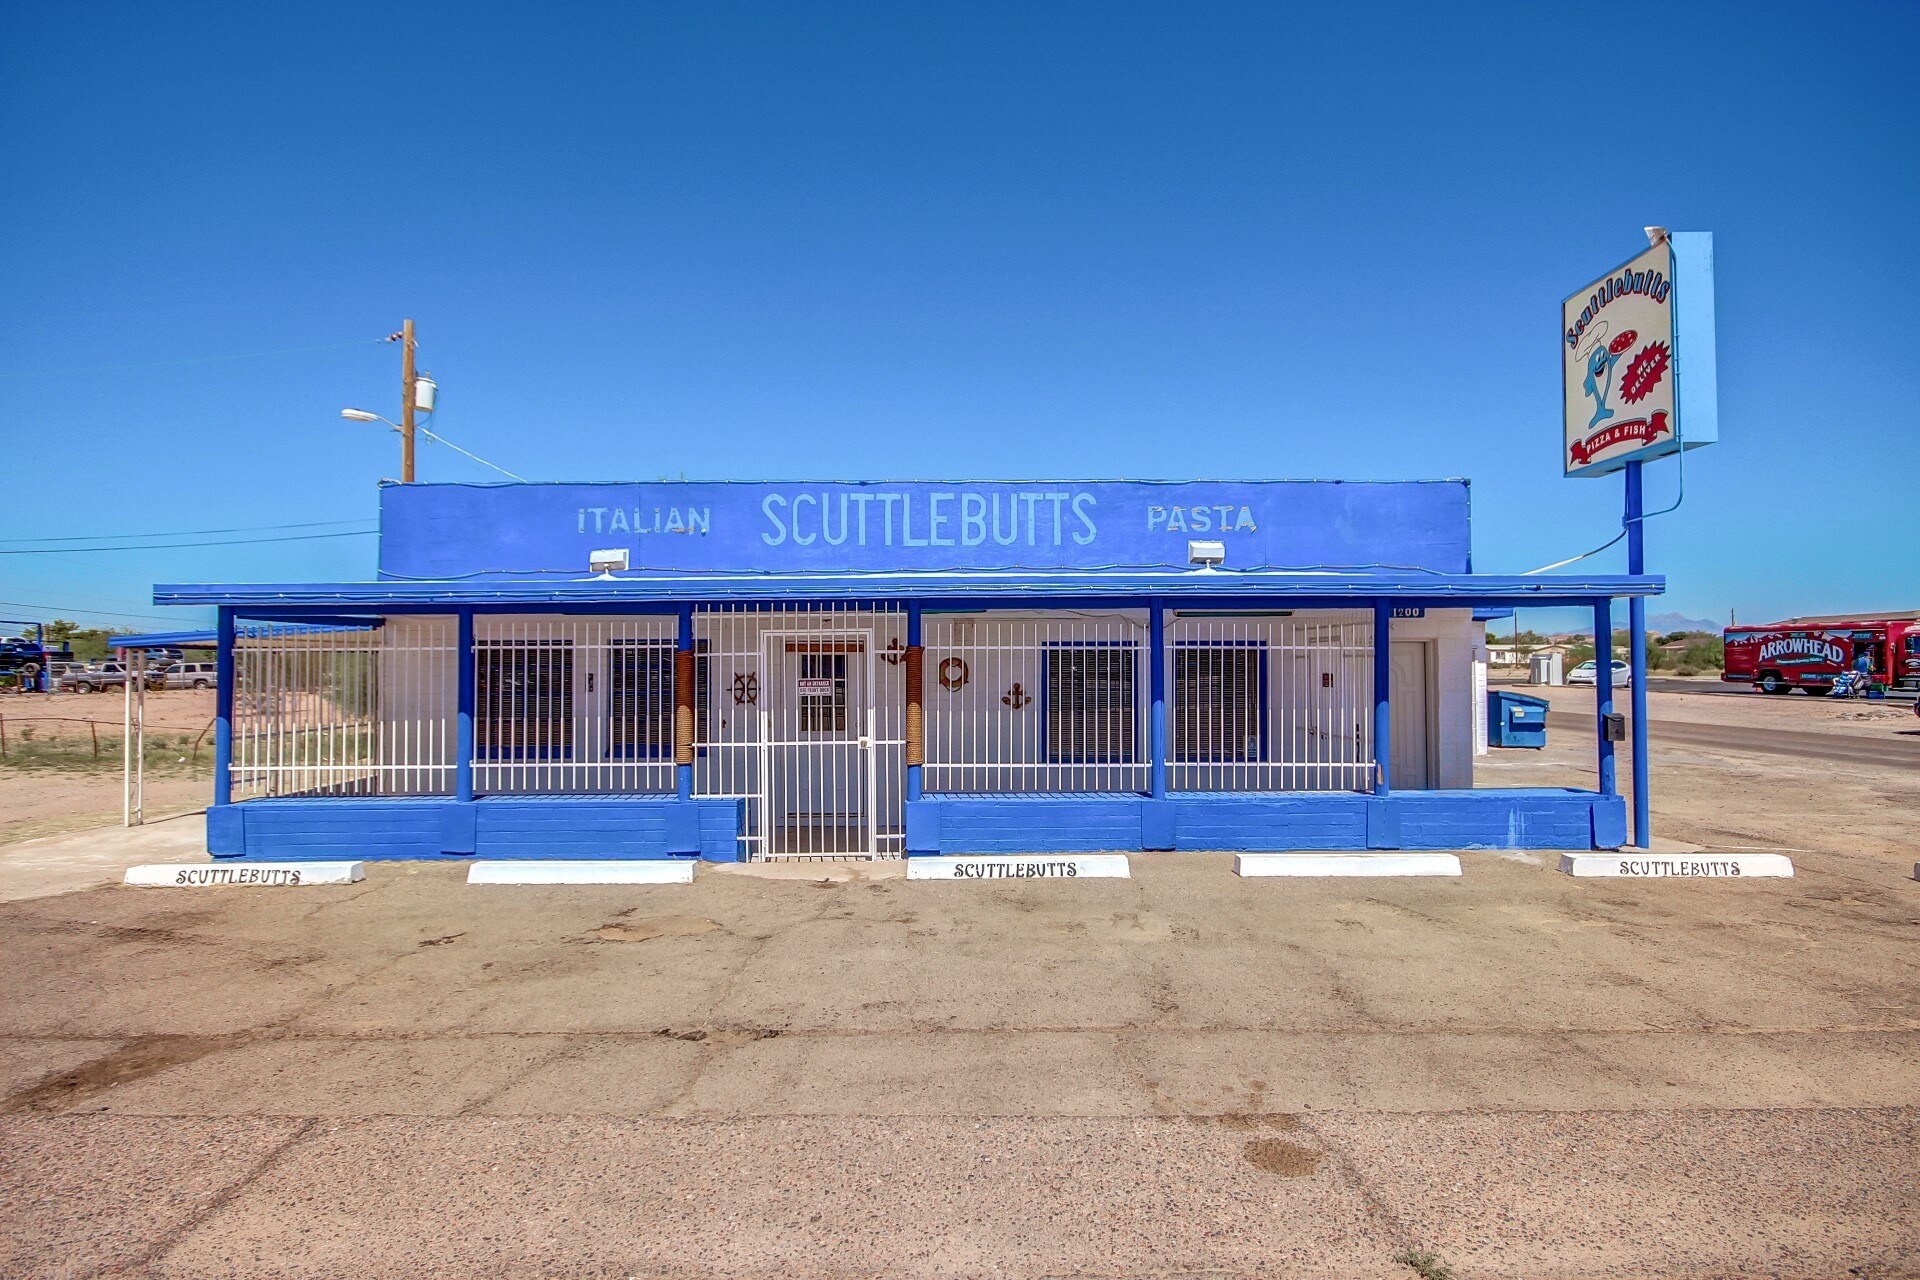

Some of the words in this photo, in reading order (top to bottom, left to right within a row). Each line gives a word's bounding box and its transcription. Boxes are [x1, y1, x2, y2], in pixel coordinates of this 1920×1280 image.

[1631, 353, 1662, 395] DELIVER
[1637, 359, 1649, 375] WE
[1586, 432, 1611, 454] PIZZA
[1614, 428, 1621, 438] &
[1624, 424, 1646, 436] FISH
[578, 507, 711, 535] ITALIAN
[760, 492, 1098, 547] SCUTTLEBUTTS
[1147, 505, 1257, 533] PASTA
[1393, 607, 1420, 618] 1200
[1758, 637, 1844, 664] ARROWHEAD
[175, 868, 302, 885] SCUTTLEBUTTS
[953, 862, 1077, 878] SCUTTLEBUTTS
[1619, 861, 1741, 877] SCUTTLEBUTTS
